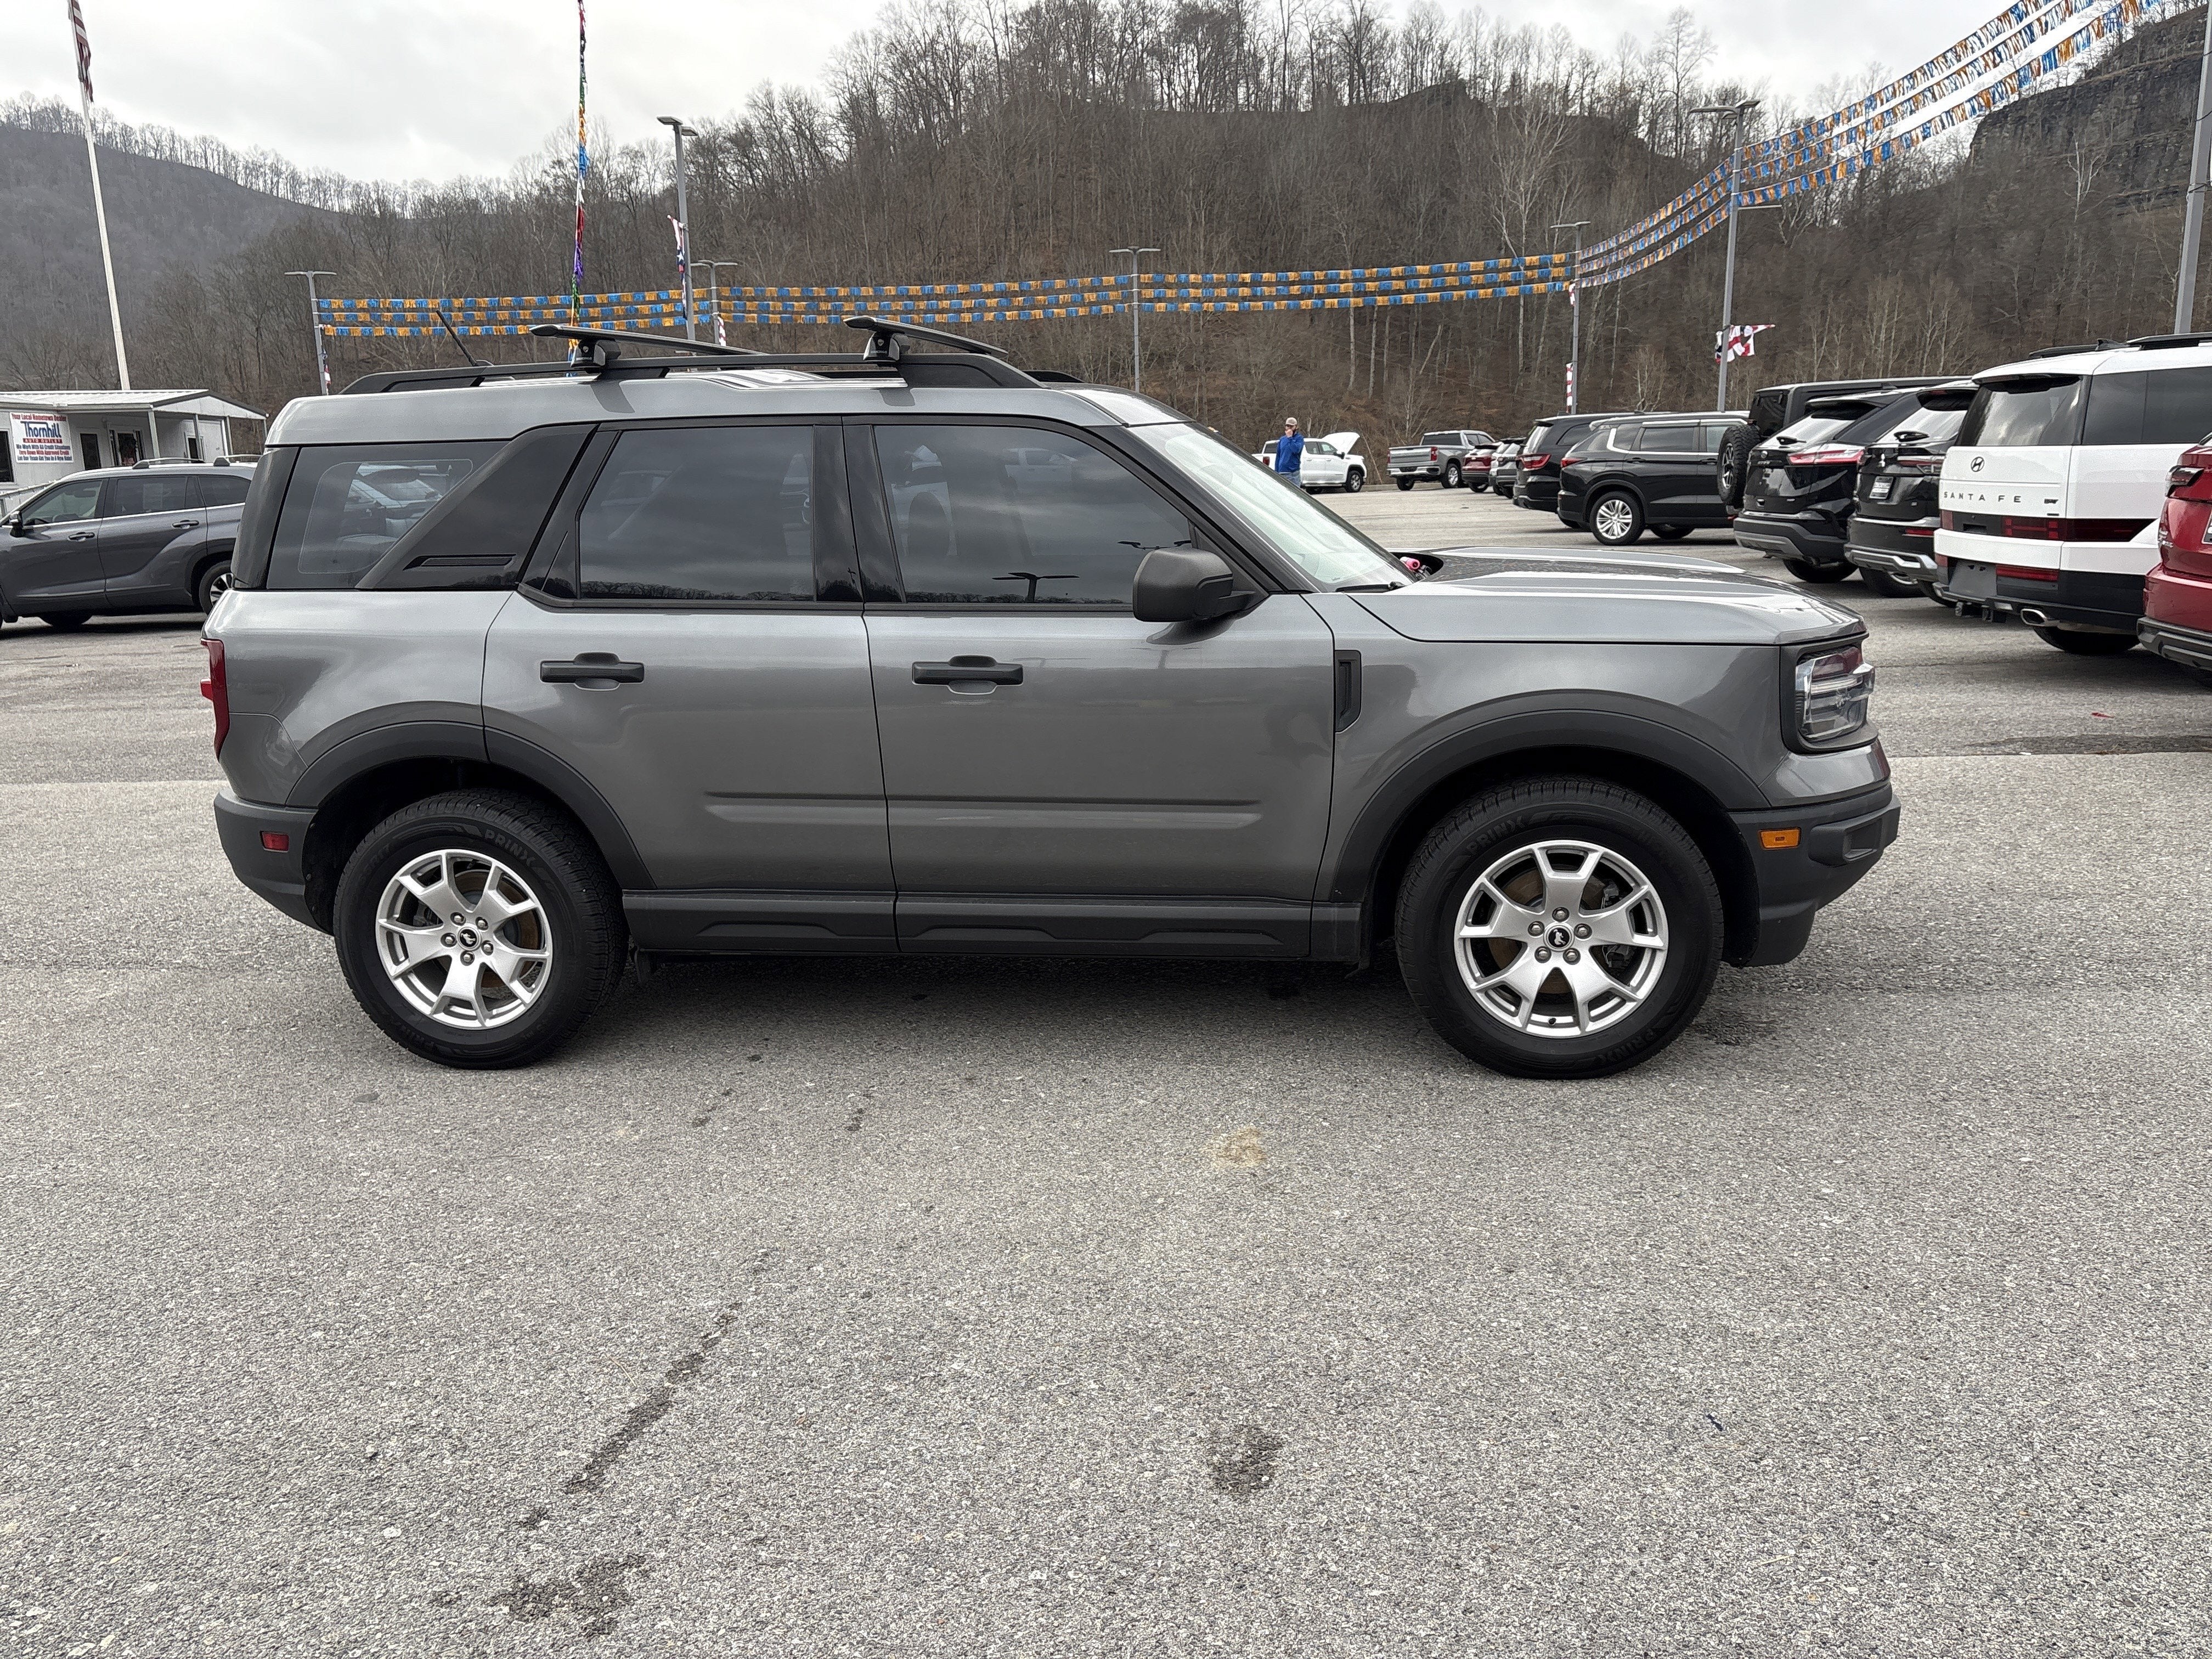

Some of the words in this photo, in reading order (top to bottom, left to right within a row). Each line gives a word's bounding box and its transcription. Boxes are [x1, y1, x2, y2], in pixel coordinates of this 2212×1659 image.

[20, 421, 61, 438] Thornhill
[1944, 491, 1986, 501] SANTA
[1997, 495, 2022, 503] FE
[484, 829, 537, 867] PRINX
[1466, 815, 1527, 857] PRINX
